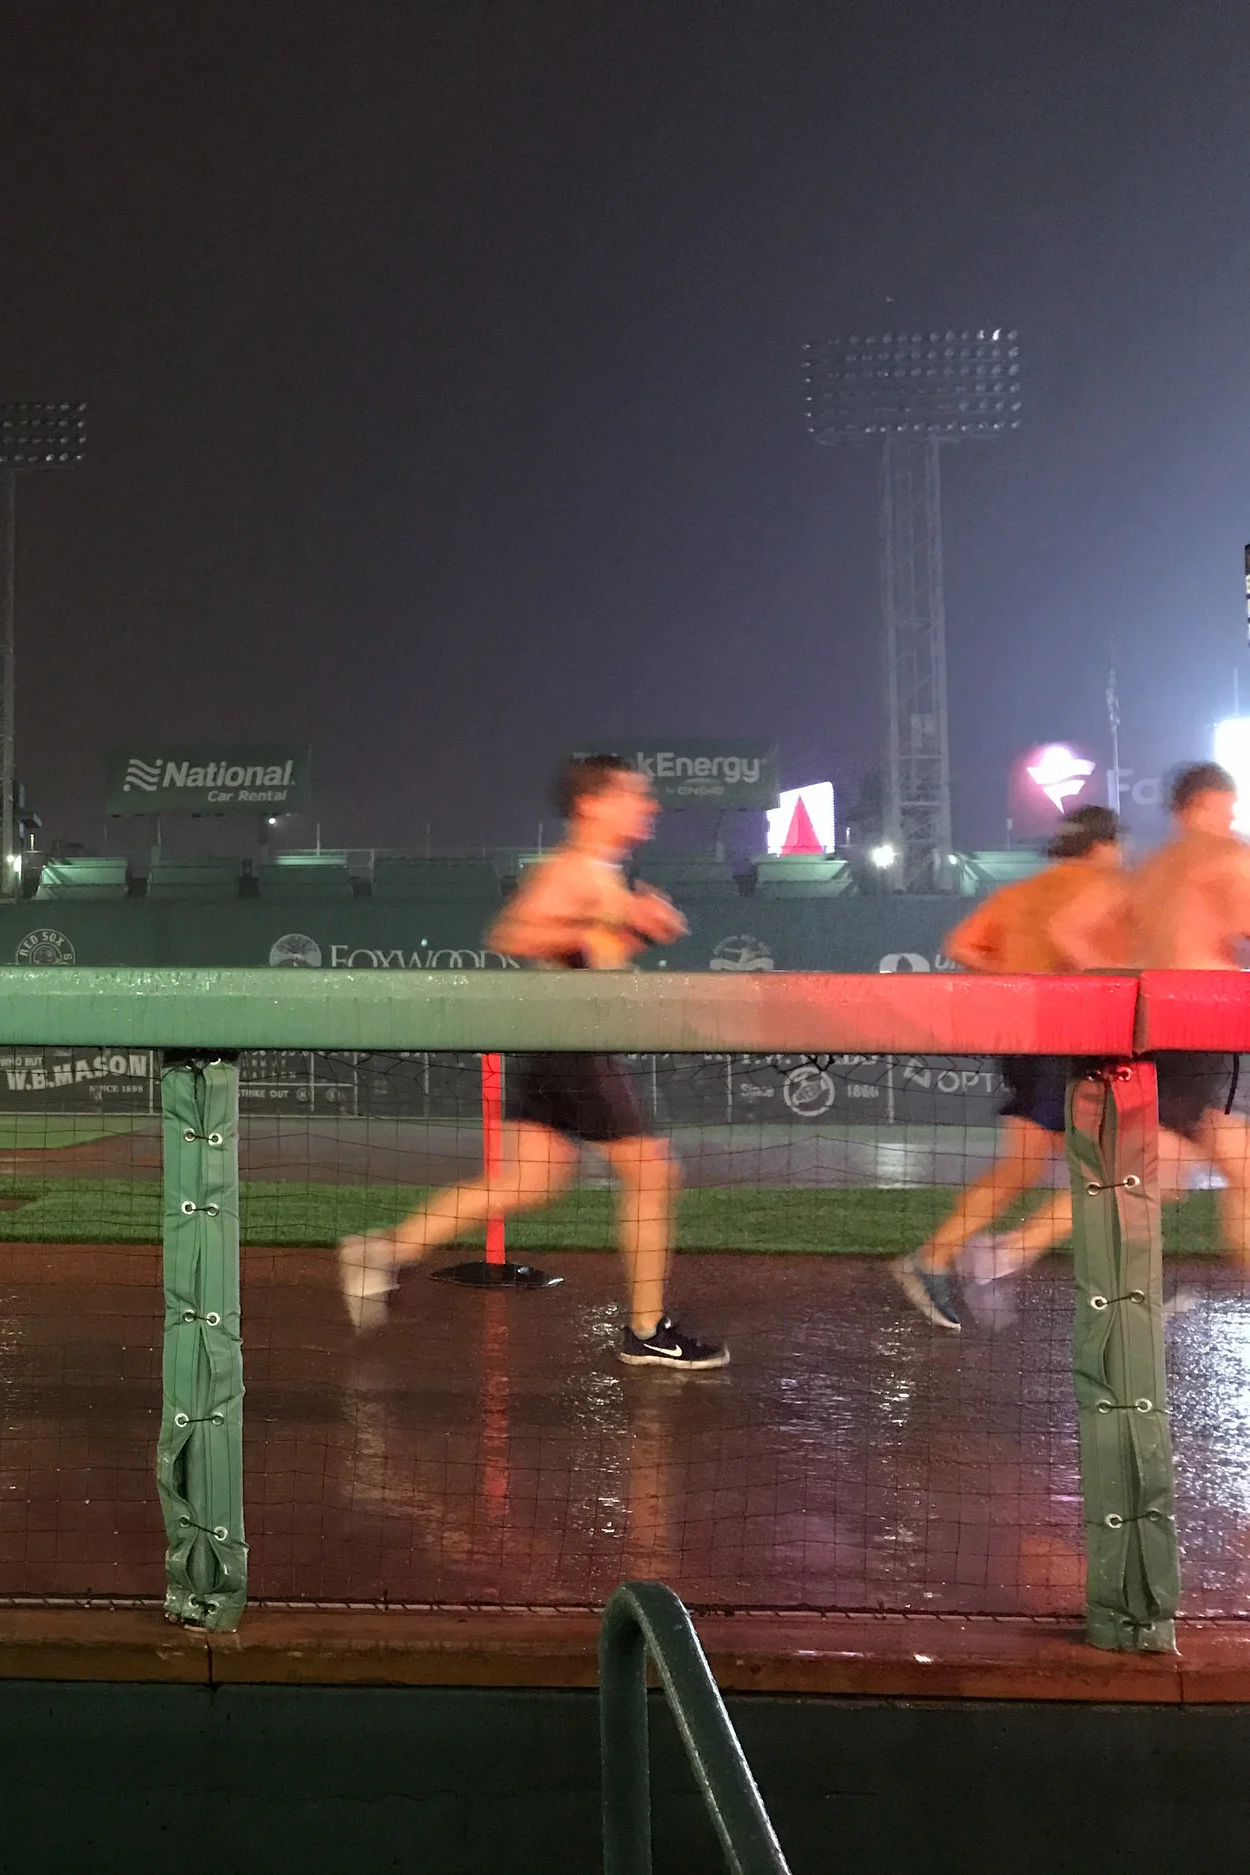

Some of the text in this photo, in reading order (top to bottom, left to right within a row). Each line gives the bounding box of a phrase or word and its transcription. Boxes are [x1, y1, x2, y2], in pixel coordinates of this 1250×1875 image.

[162, 760, 293, 788] National
[207, 790, 288, 802] Car Rental
